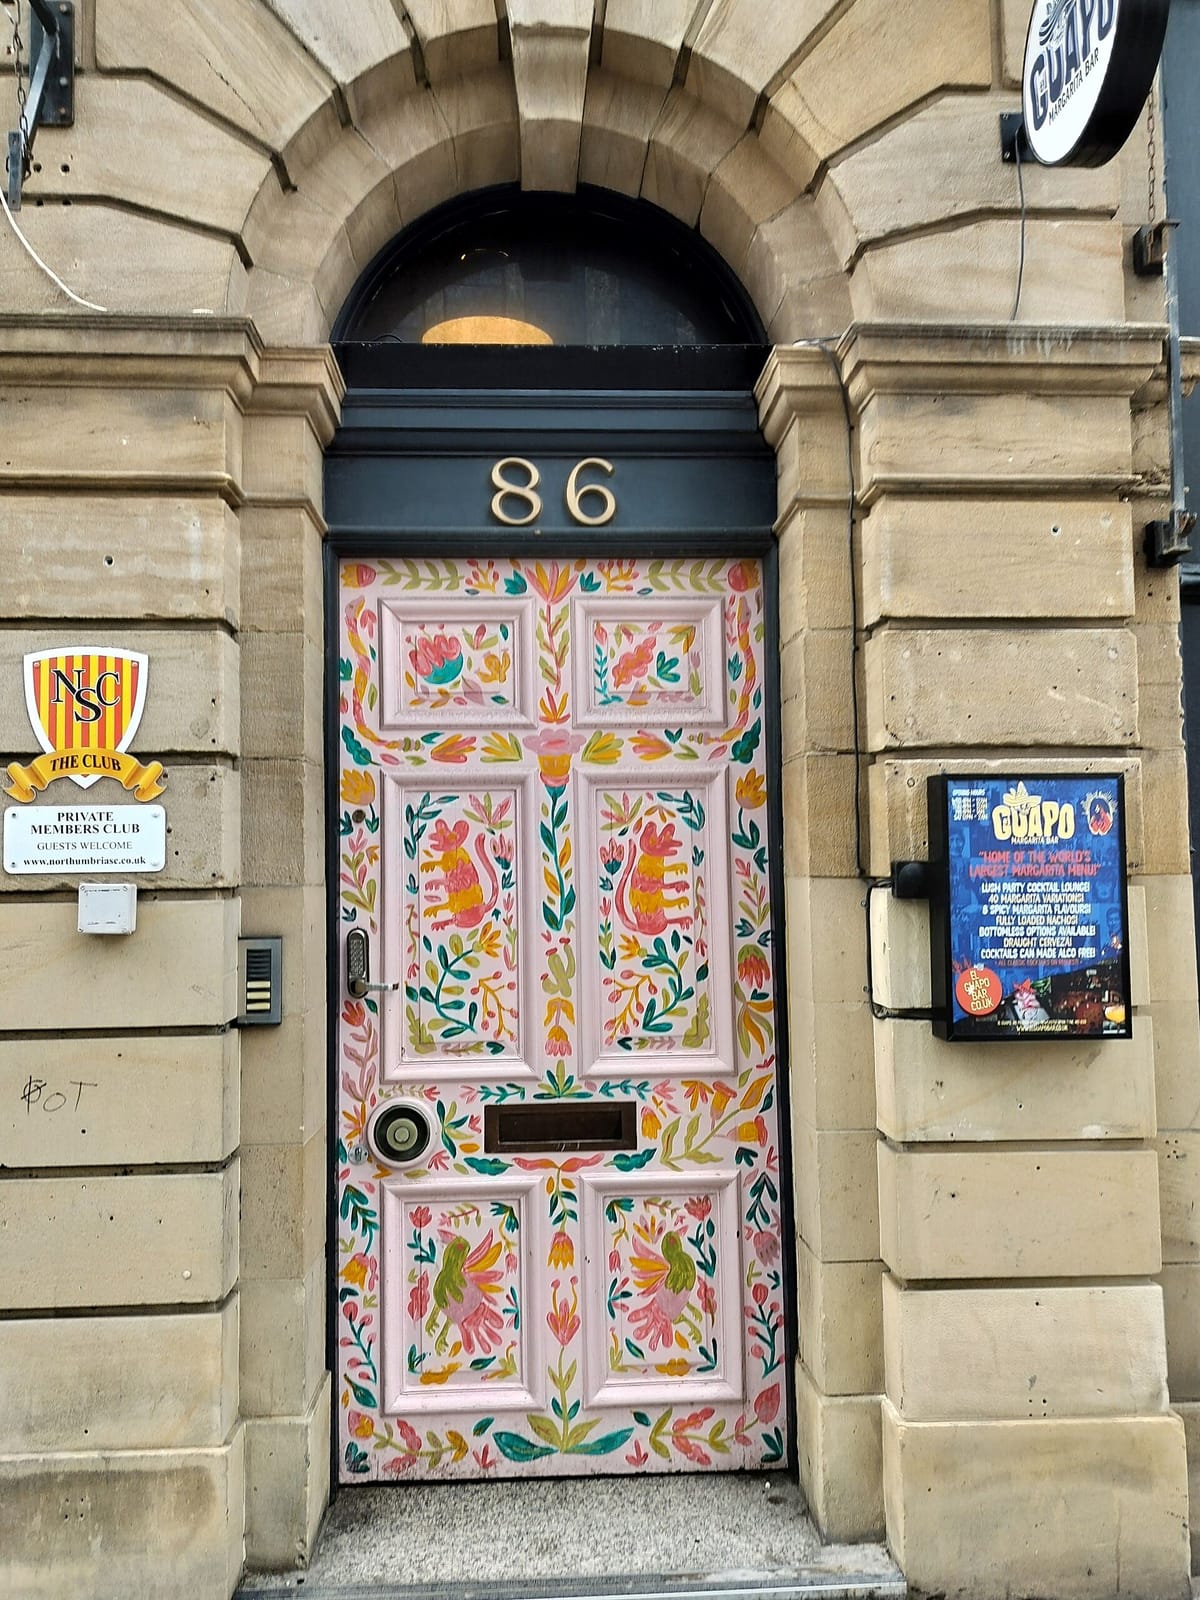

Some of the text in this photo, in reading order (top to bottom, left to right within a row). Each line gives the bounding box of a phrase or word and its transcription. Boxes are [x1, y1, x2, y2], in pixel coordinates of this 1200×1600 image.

[1049, 47, 1099, 125] MARGARITA BAR
[491, 456, 616, 526] 86
[50, 754, 122, 772] THE CLUB
[57, 811, 114, 822] PRIVATE
[991, 801, 1075, 841] GUAPO
[31, 823, 140, 835] MEMBERS CLUB
[37, 841, 133, 851] GUESTS WELCOME
[1014, 850, 1025, 864] OF
[1028, 850, 1045, 864] THE
[969, 864, 1009, 878] LARGEST
[1012, 864, 1065, 877] MARGARITA
[981, 882, 1000, 893] LUSH
[1002, 882, 1025, 893] PARTY
[1027, 882, 1060, 892] COCKTAIL
[988, 894, 999, 904] 40
[1001, 894, 1041, 904] MARGARITA
[990, 904, 1011, 915] SPICY
[1012, 904, 1053, 914] MARGARITA
[996, 915, 1017, 926] FULLY
[1018, 915, 1045, 925] LOADED
[979, 926, 1025, 937] BOTTOMLESS
[1026, 926, 1057, 936] OPTIONS
[1003, 937, 1037, 948] DRAUGHT
[981, 948, 1018, 959] COCKTAILS
[1058, 948, 1076, 958] ALCO
[969, 970, 980, 981] EL
[971, 988, 988, 1001] BAR
